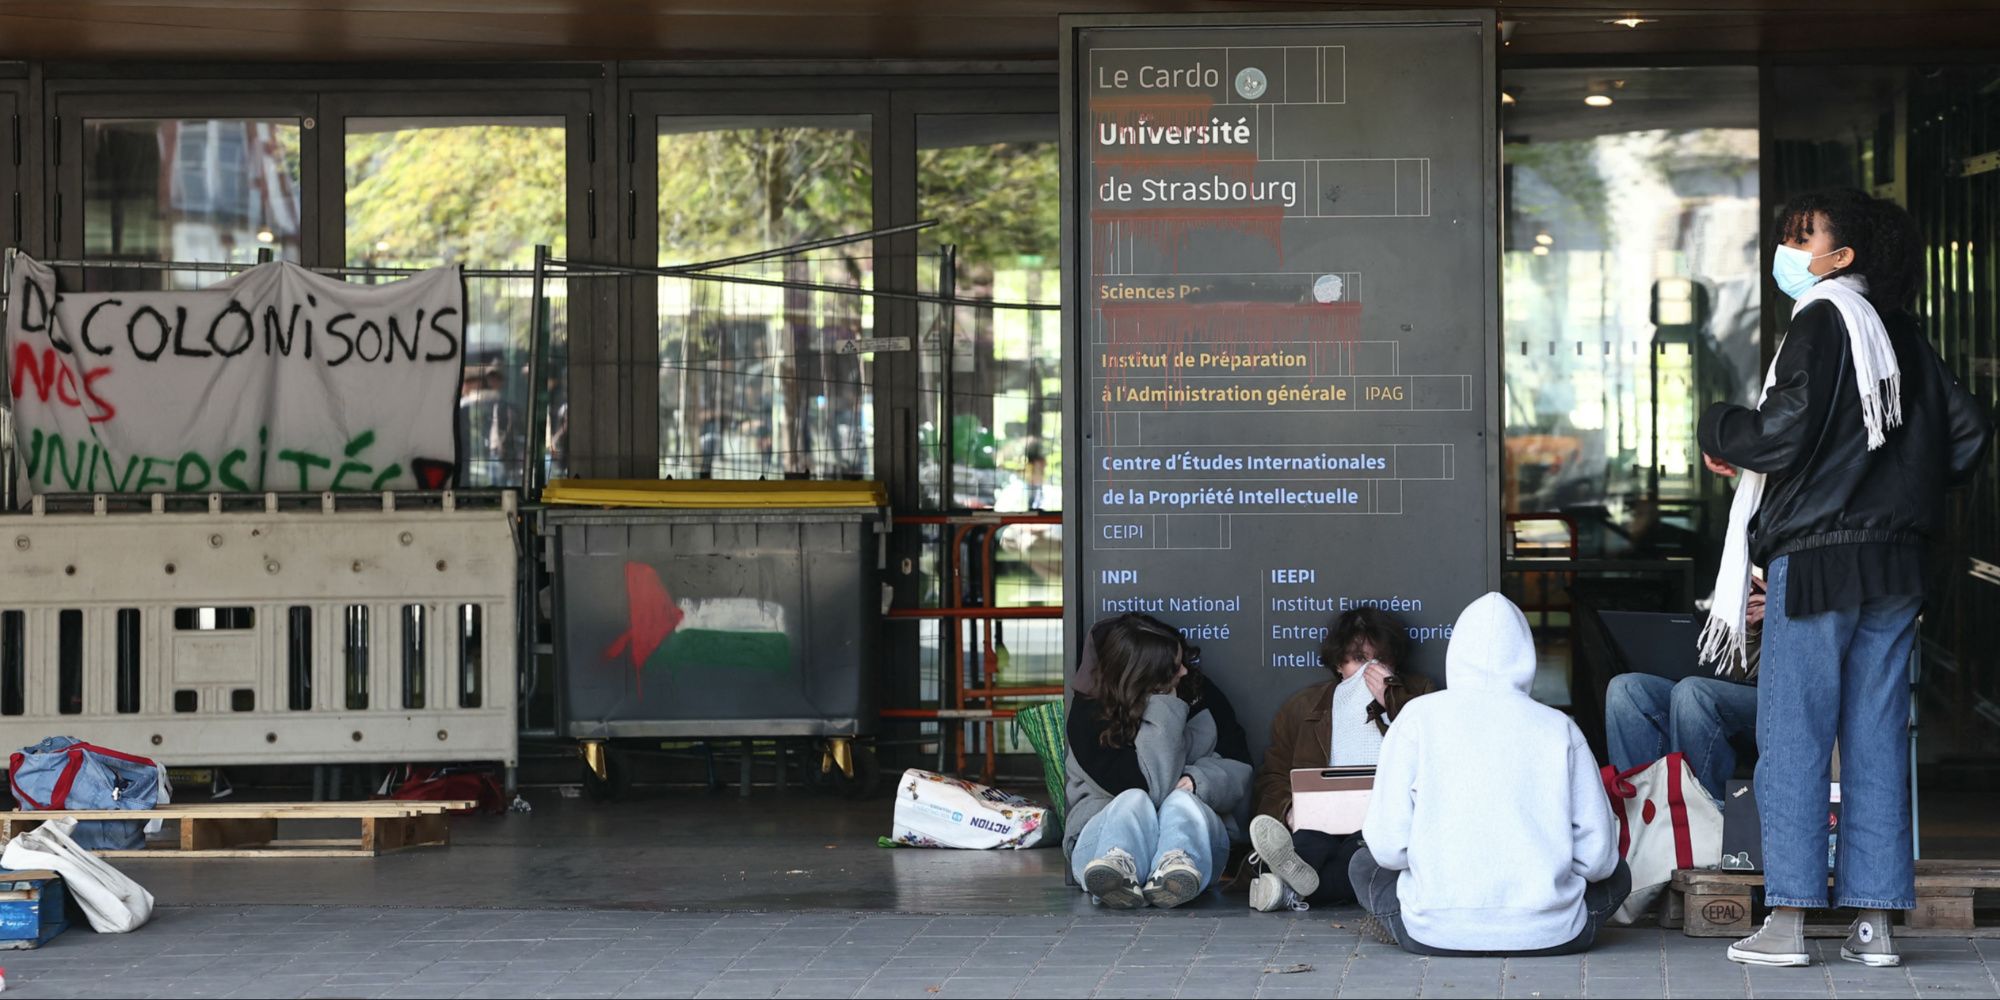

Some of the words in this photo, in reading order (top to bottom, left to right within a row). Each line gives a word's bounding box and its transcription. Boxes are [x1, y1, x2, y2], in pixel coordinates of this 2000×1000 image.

[1100, 67, 1128, 89] Le
[1140, 62, 1219, 89] Cardo
[1100, 117, 1250, 146] Université
[1099, 176, 1132, 202] de
[1143, 175, 1297, 208] Strasbourg
[1101, 283, 1175, 299] Sciences
[1102, 351, 1167, 369] Institut
[1174, 352, 1195, 369] de
[1200, 351, 1307, 372] Préparation
[12, 342, 117, 423] NOS
[1102, 385, 1112, 402] à
[1117, 384, 1261, 403] l'Administration
[1267, 384, 1347, 406] générale
[1365, 386, 1404, 401] IPAG
[1102, 456, 1161, 471] Centre
[1166, 450, 1243, 471] d’Études
[1248, 453, 1386, 470] Internationales
[1103, 489, 1125, 505] de
[1130, 489, 1144, 505] la
[1150, 487, 1235, 509] Propriété
[1239, 487, 1359, 504] Intellectuelle
[1103, 524, 1144, 540] CEIPI
[1102, 570, 1138, 584] INPI
[1272, 569, 1315, 584] IEEPI
[1103, 596, 1164, 612] Institut
[1170, 595, 1240, 612] National
[1272, 595, 1333, 612] Institut
[970, 816, 1012, 835] ACTION
[1709, 904, 1740, 920] EPAL
